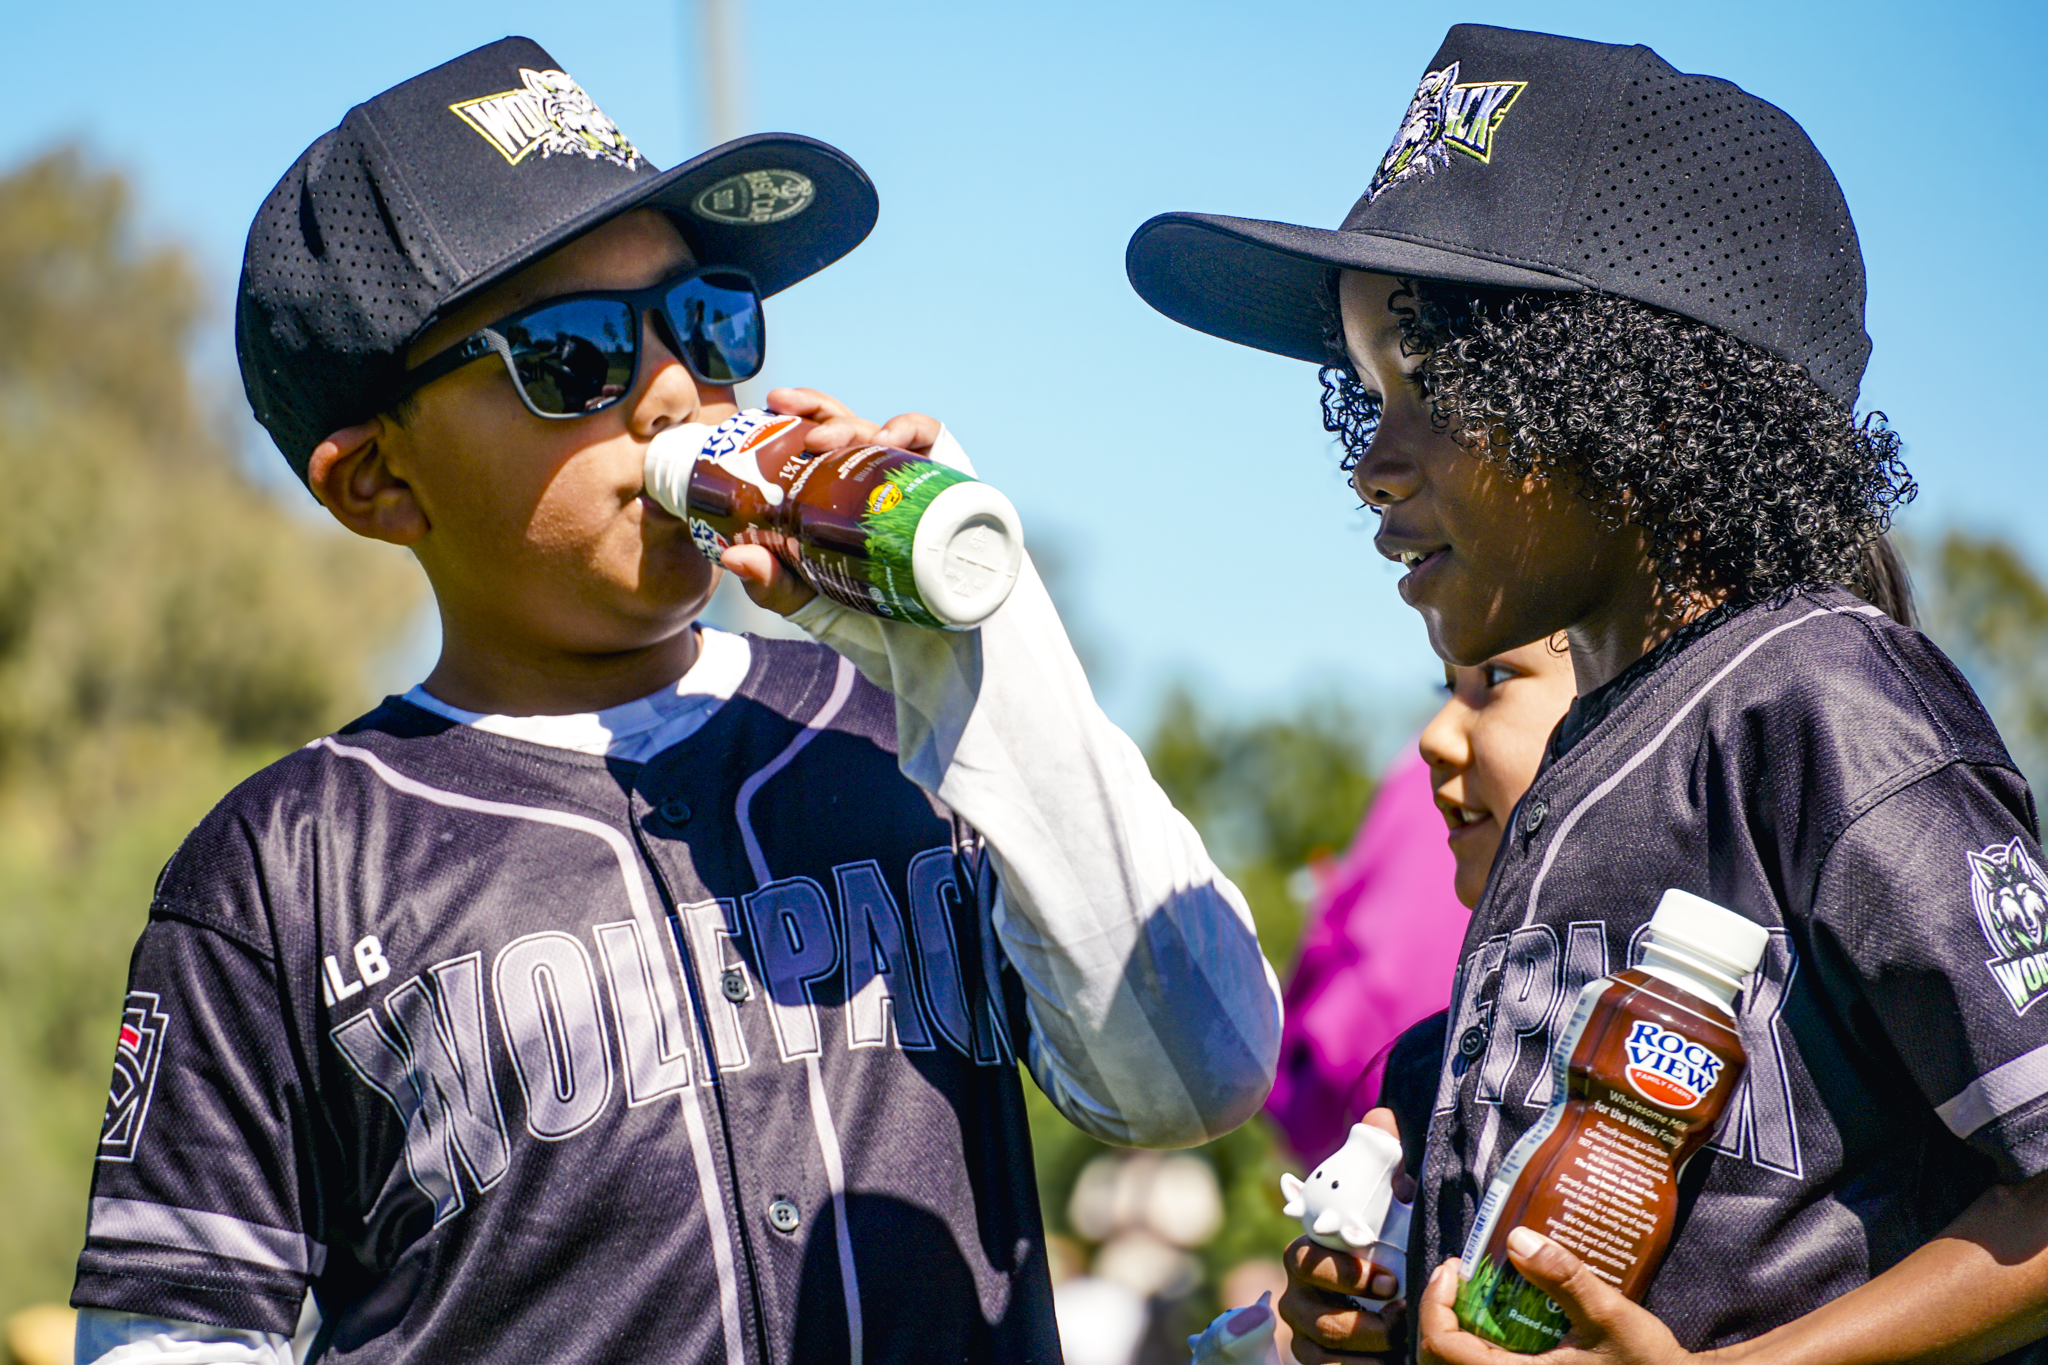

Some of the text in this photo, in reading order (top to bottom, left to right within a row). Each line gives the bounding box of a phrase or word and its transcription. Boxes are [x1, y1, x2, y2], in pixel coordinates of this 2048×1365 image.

[779, 460, 801, 481] 1%
[885, 565, 901, 606] Rockview
[1630, 1023, 1721, 1080] ROCK
[1629, 1045, 1712, 1094] VIEW
[1635, 1071, 1693, 1101] FAMILY FARMS
[1593, 1100, 1684, 1149] for the Whole Family
[1609, 1090, 1688, 1131] Wholesome Milk
[1584, 1127, 1616, 1147] California's
[1615, 1142, 1646, 1160] hometown
[1595, 1120, 1620, 1138] Proudly
[1618, 1132, 1640, 1147] serving
[1587, 1152, 1600, 1162] the
[1598, 1157, 1614, 1169] best
[1613, 1163, 1624, 1172] for
[1622, 1169, 1637, 1178] your
[1591, 1144, 1609, 1156] we're
[1608, 1152, 1641, 1169] committed
[1574, 1157, 1587, 1168] The
[1585, 1162, 1602, 1174] best
[1629, 1182, 1644, 1193] best
[1587, 1174, 1600, 1185] the
[1599, 1179, 1615, 1192] best
[1554, 1183, 1578, 1198] Farms
[1576, 1193, 1596, 1205] label
[1606, 1207, 1628, 1221] stamp
[1559, 1173, 1584, 1190] Simply
[1597, 1191, 1611, 1201] the
[1609, 1196, 1641, 1214] Rockview
[1562, 1198, 1590, 1215] backed
[1588, 1209, 1600, 1221] by
[1599, 1214, 1621, 1230] family
[1562, 1212, 1585, 1227] We're
[1583, 1223, 1608, 1237] proud
[1546, 1216, 1583, 1238] important
[1581, 1234, 1598, 1245] part
[1606, 1245, 1637, 1264] nourishing
[1549, 1229, 1578, 1248] families
[1577, 1242, 1589, 1252] for
[1509, 1308, 1542, 1330] Raised
[1541, 1326, 1553, 1336] on
